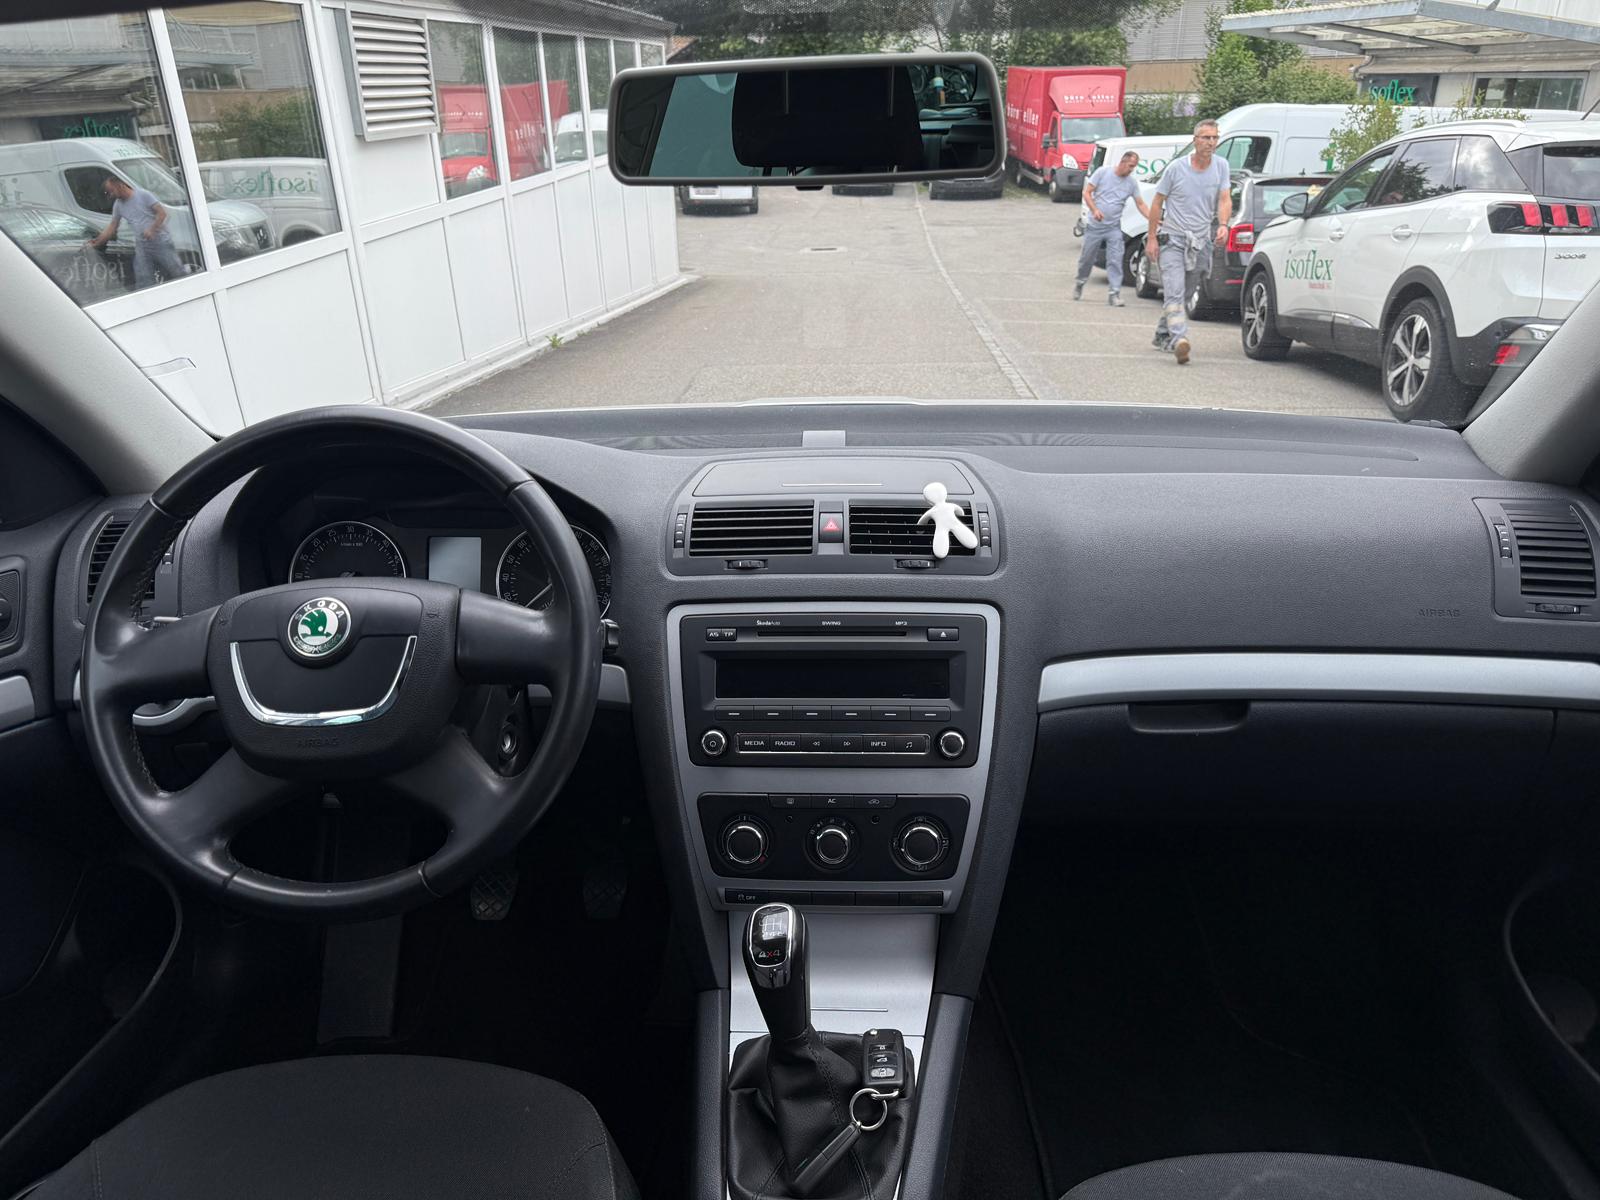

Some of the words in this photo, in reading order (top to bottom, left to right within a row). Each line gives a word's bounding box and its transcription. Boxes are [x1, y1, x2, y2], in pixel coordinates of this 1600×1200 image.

[1284, 249, 1334, 281] isoflex
[345, 525, 355, 533] 30
[502, 573, 510, 582] 40
[1418, 609, 1460, 617] AIRBAG
